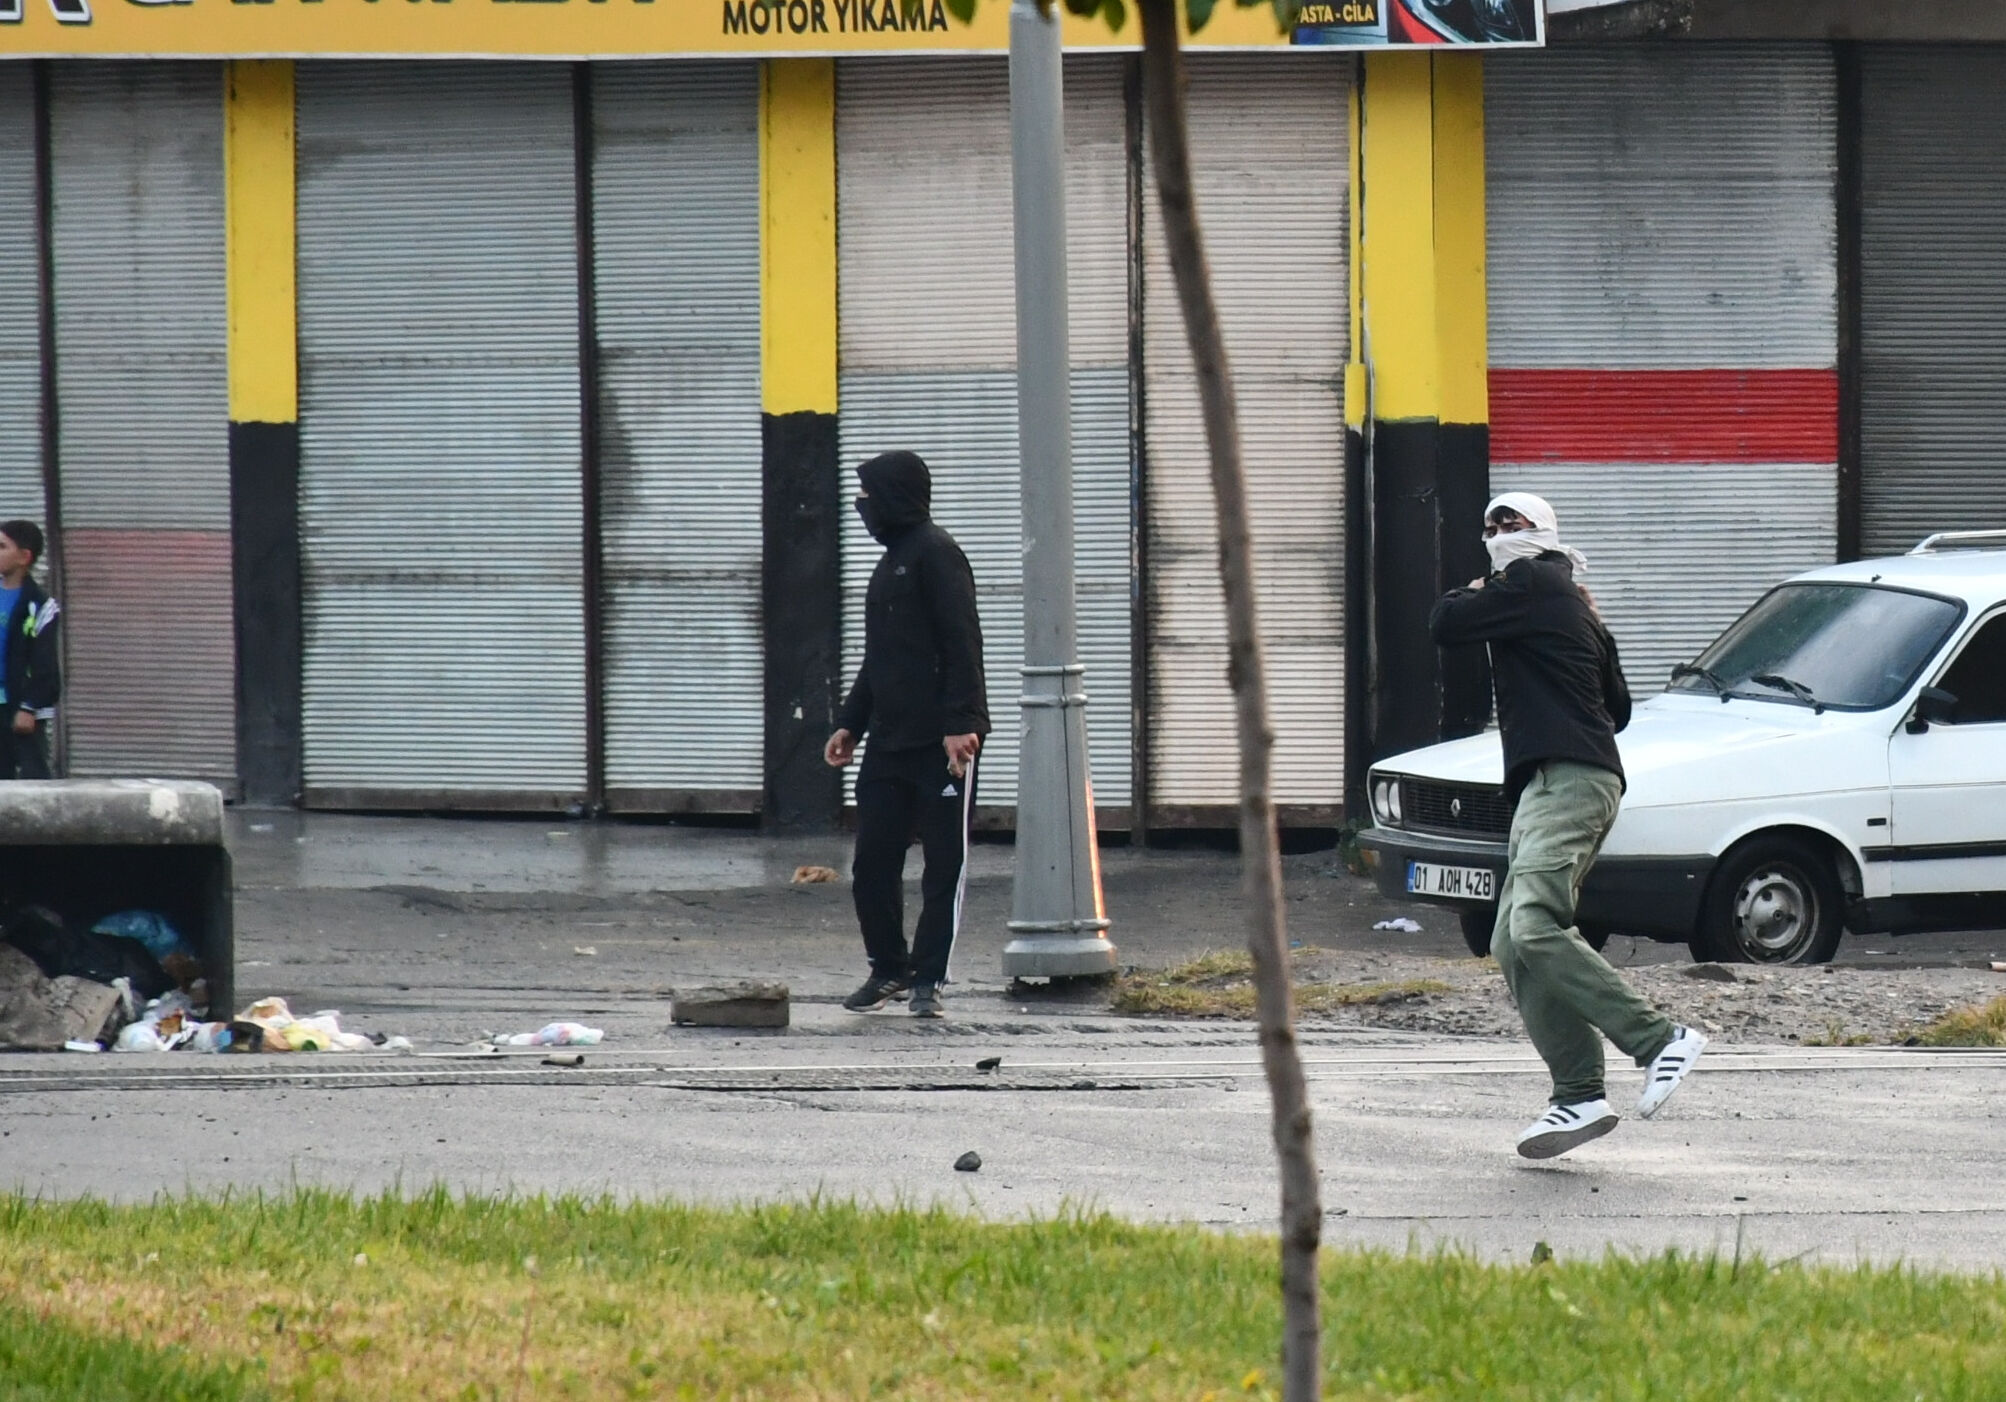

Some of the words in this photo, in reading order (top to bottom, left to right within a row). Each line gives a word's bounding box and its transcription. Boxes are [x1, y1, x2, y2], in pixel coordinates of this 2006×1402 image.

[723, 0, 829, 34] MOTOR
[832, 0, 949, 32] YIKAMA
[1293, 5, 1334, 23] ASTA
[1414, 866, 1428, 890] 01
[1438, 868, 1461, 893] AOH
[1465, 871, 1491, 896] 428
